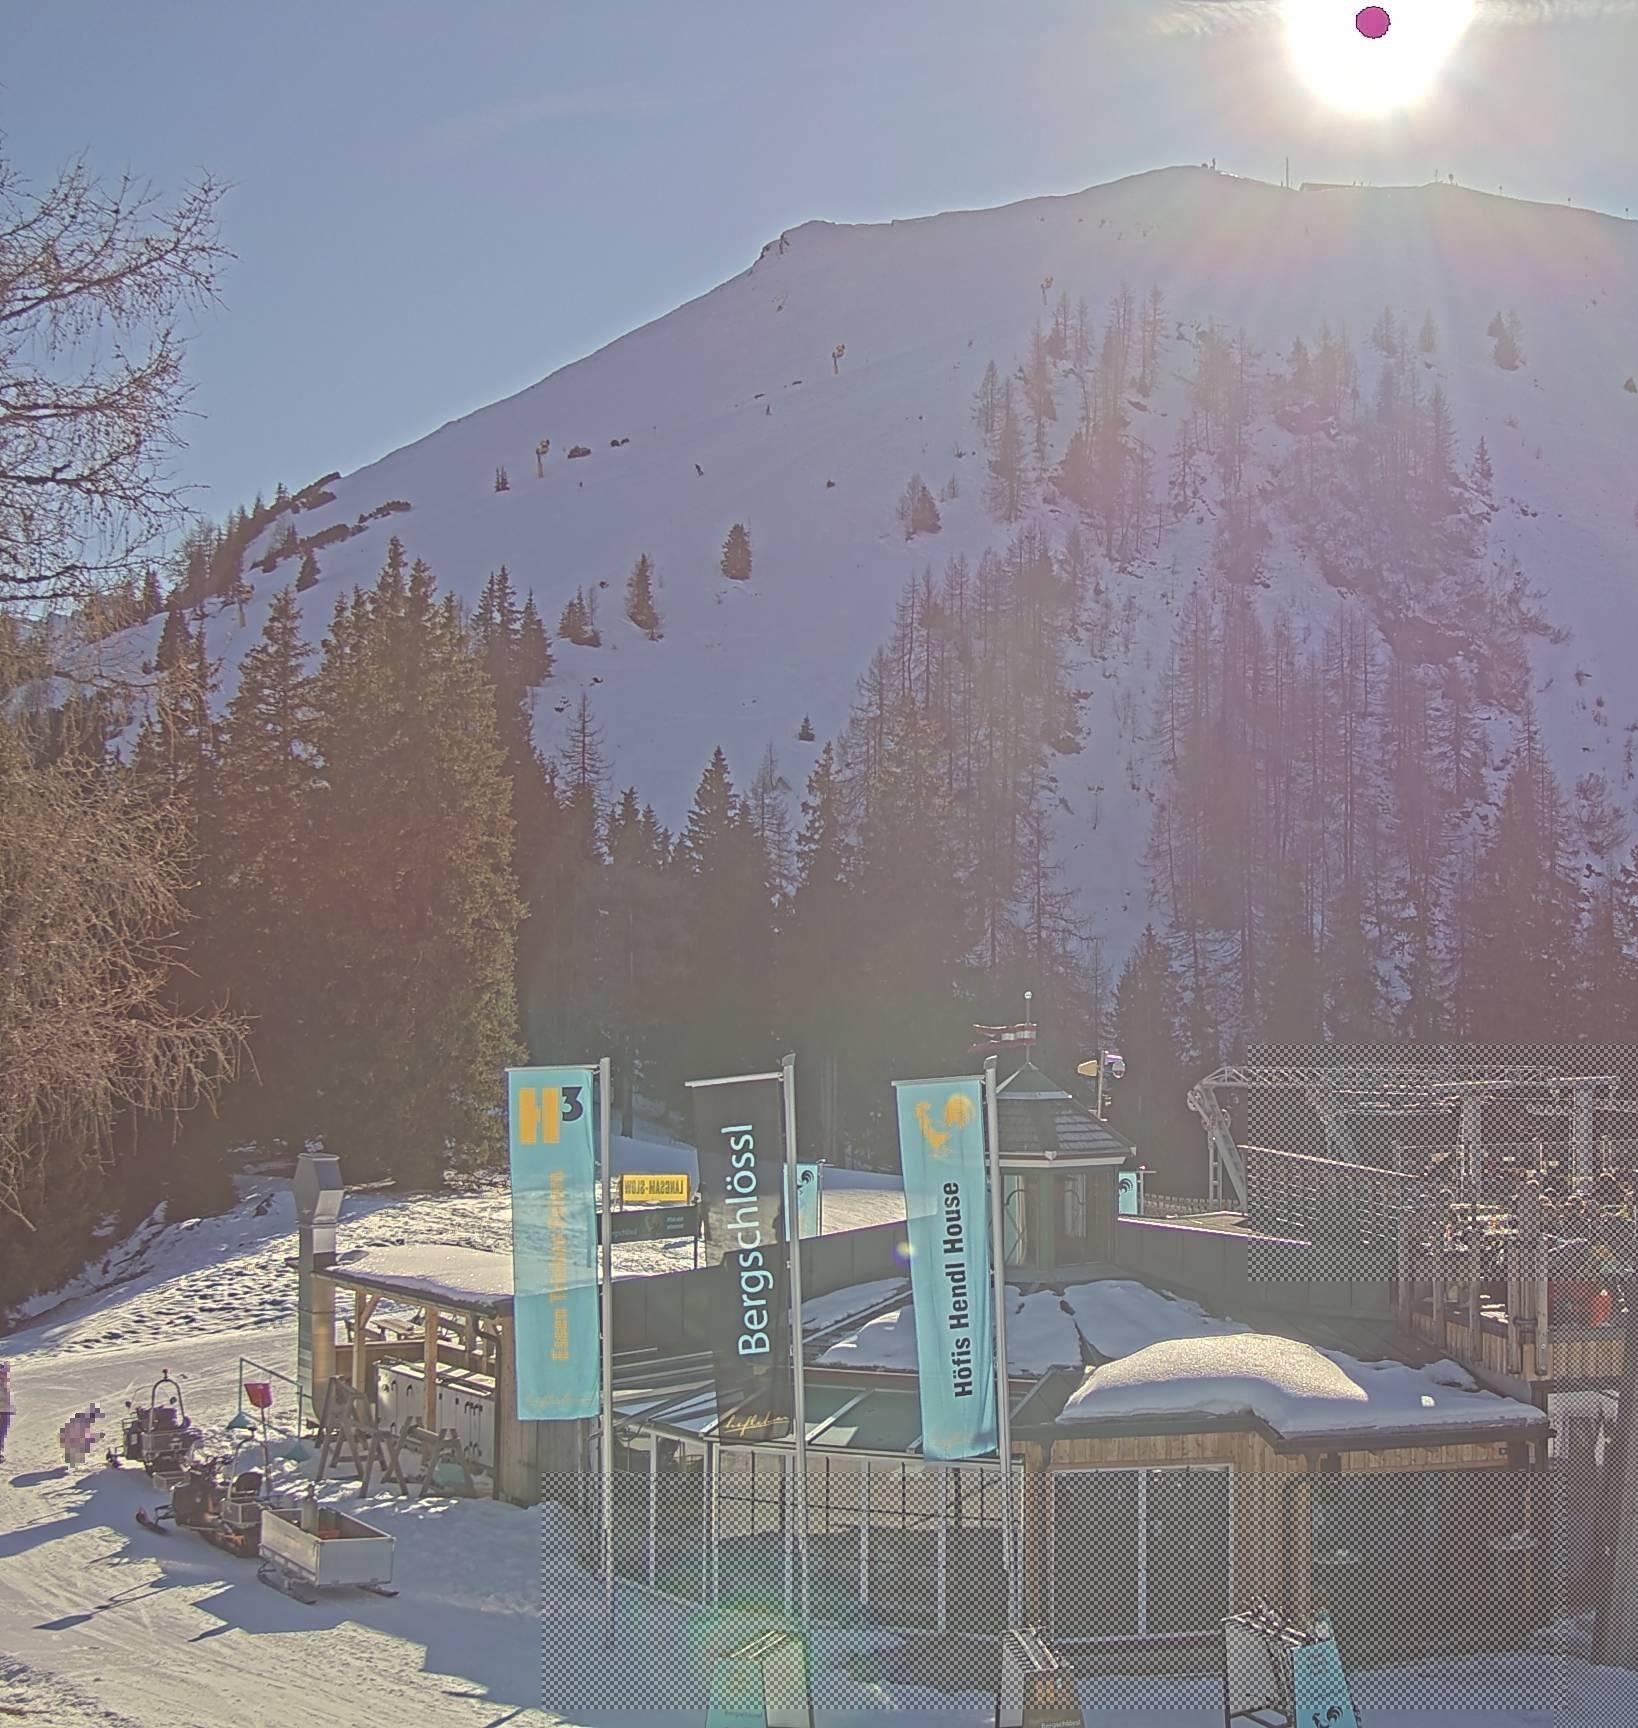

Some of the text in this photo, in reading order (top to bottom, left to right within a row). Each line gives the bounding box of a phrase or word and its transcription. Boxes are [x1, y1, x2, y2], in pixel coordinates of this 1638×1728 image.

[720, 1124, 774, 1356] Bergschlössl
[942, 1181, 974, 1399] Höfis Hendl House
